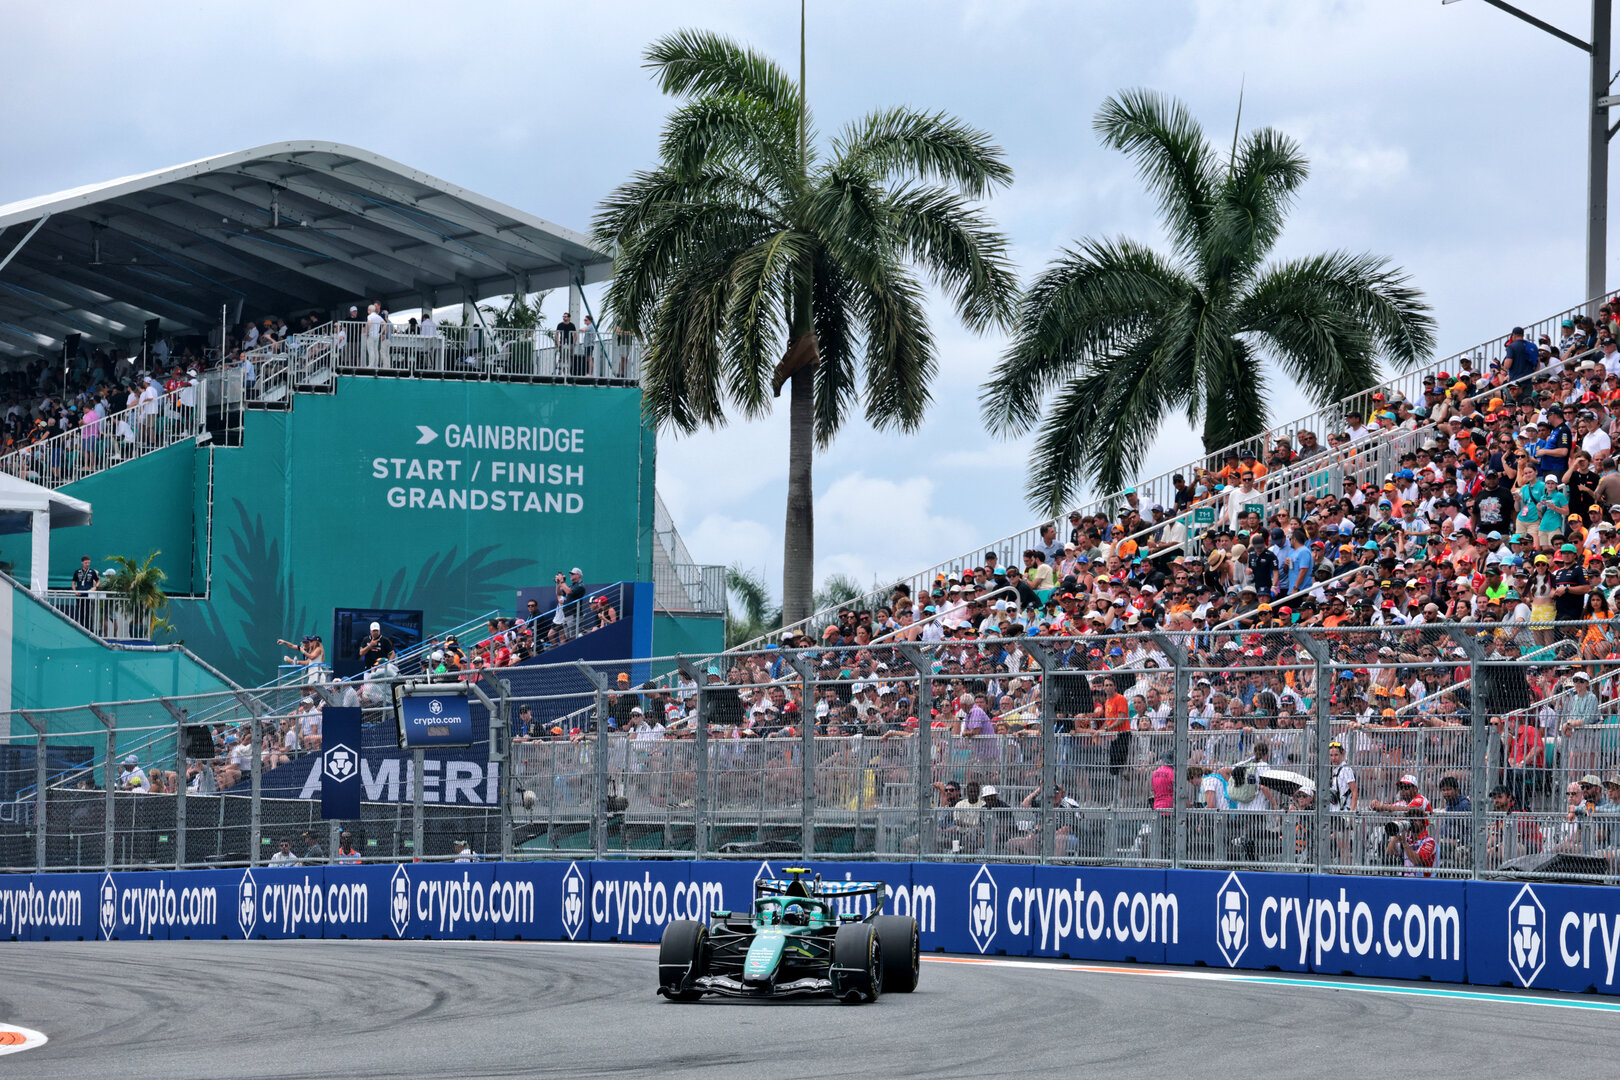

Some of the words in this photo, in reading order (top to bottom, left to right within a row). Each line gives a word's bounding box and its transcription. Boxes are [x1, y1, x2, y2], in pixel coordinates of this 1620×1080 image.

[444, 423, 585, 453] GAINBRIDGE
[372, 457, 462, 481] START
[491, 461, 584, 486] FINISH
[386, 486, 584, 514] GRANDSTAND
[413, 716, 462, 726] crypto.com
[121, 879, 217, 935] crypto.com
[262, 875, 368, 933] crypto.com
[416, 871, 535, 933] crypto.com
[592, 871, 724, 936] crypto.com
[1006, 878, 1179, 951] crypto.com
[1260, 887, 1460, 966] crypto.com
[1559, 911, 1620, 986] cry
